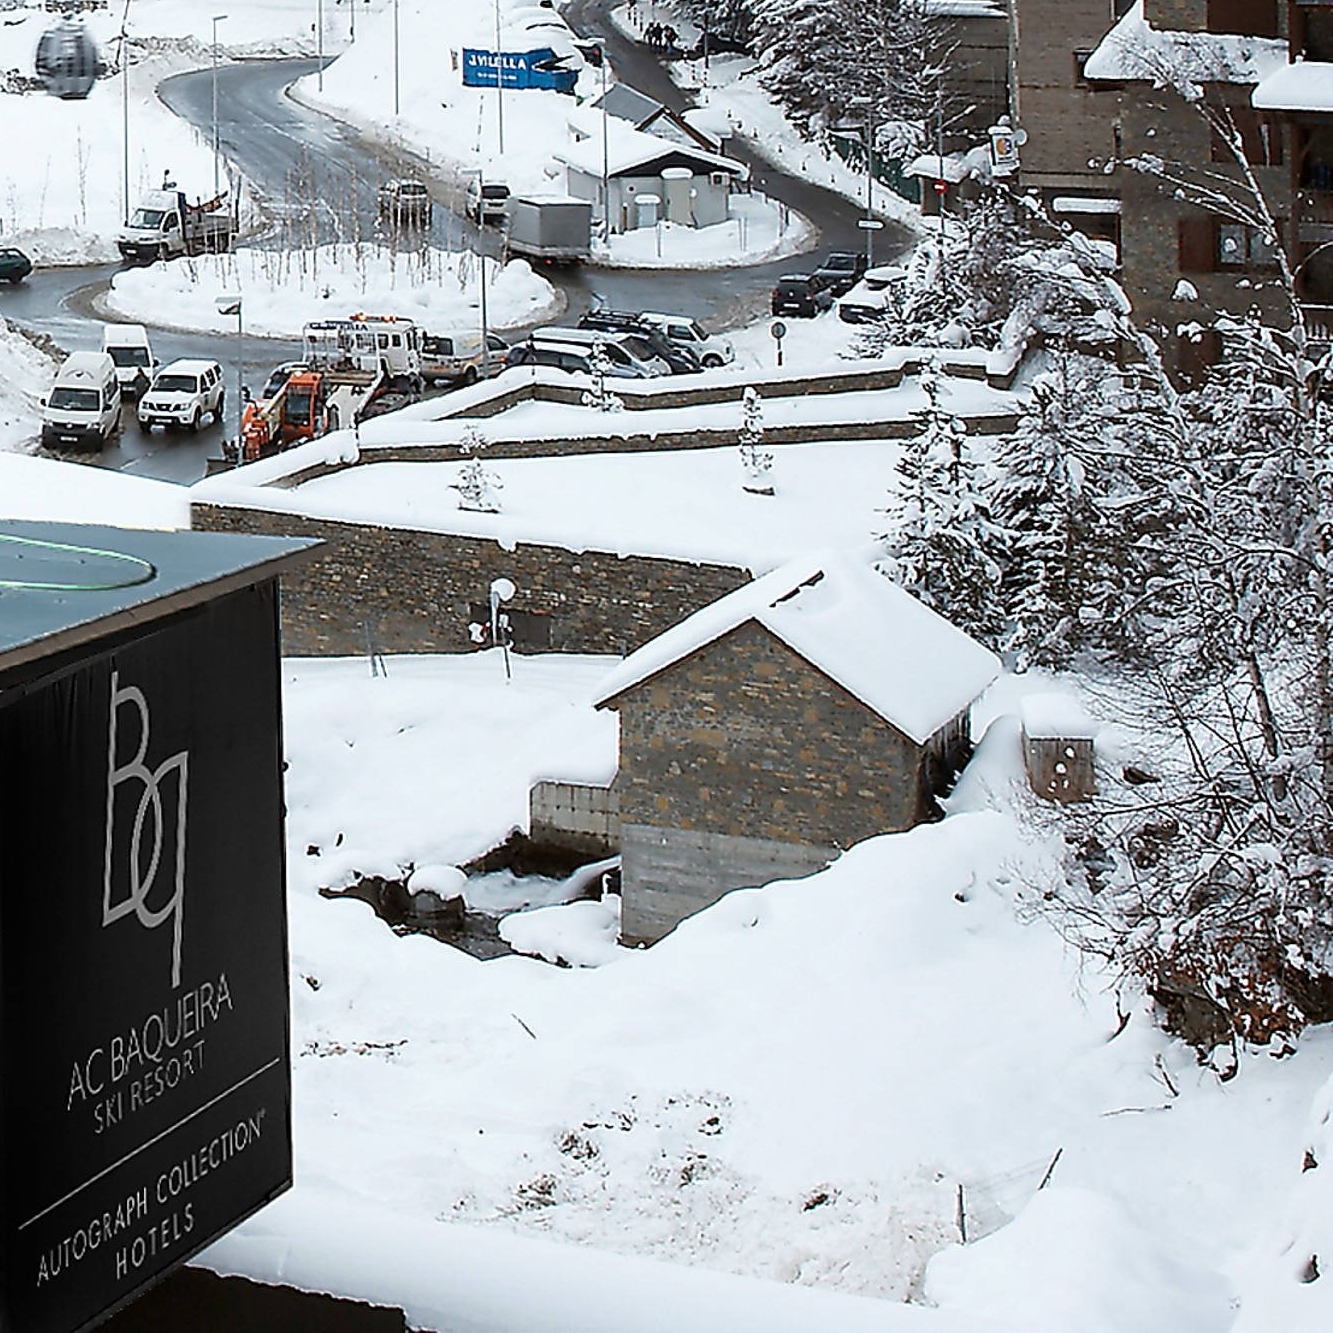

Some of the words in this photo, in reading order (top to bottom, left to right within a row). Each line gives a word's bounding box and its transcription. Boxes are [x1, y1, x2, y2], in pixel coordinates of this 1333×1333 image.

[67, 1042, 104, 1111] AC
[111, 972, 233, 1082] BAQUEIRA
[94, 1092, 123, 1134] SKI
[131, 1039, 205, 1111] RESORT
[37, 1187, 148, 1287] AUTOGRAPH
[116, 1203, 194, 1280] HOTELS
